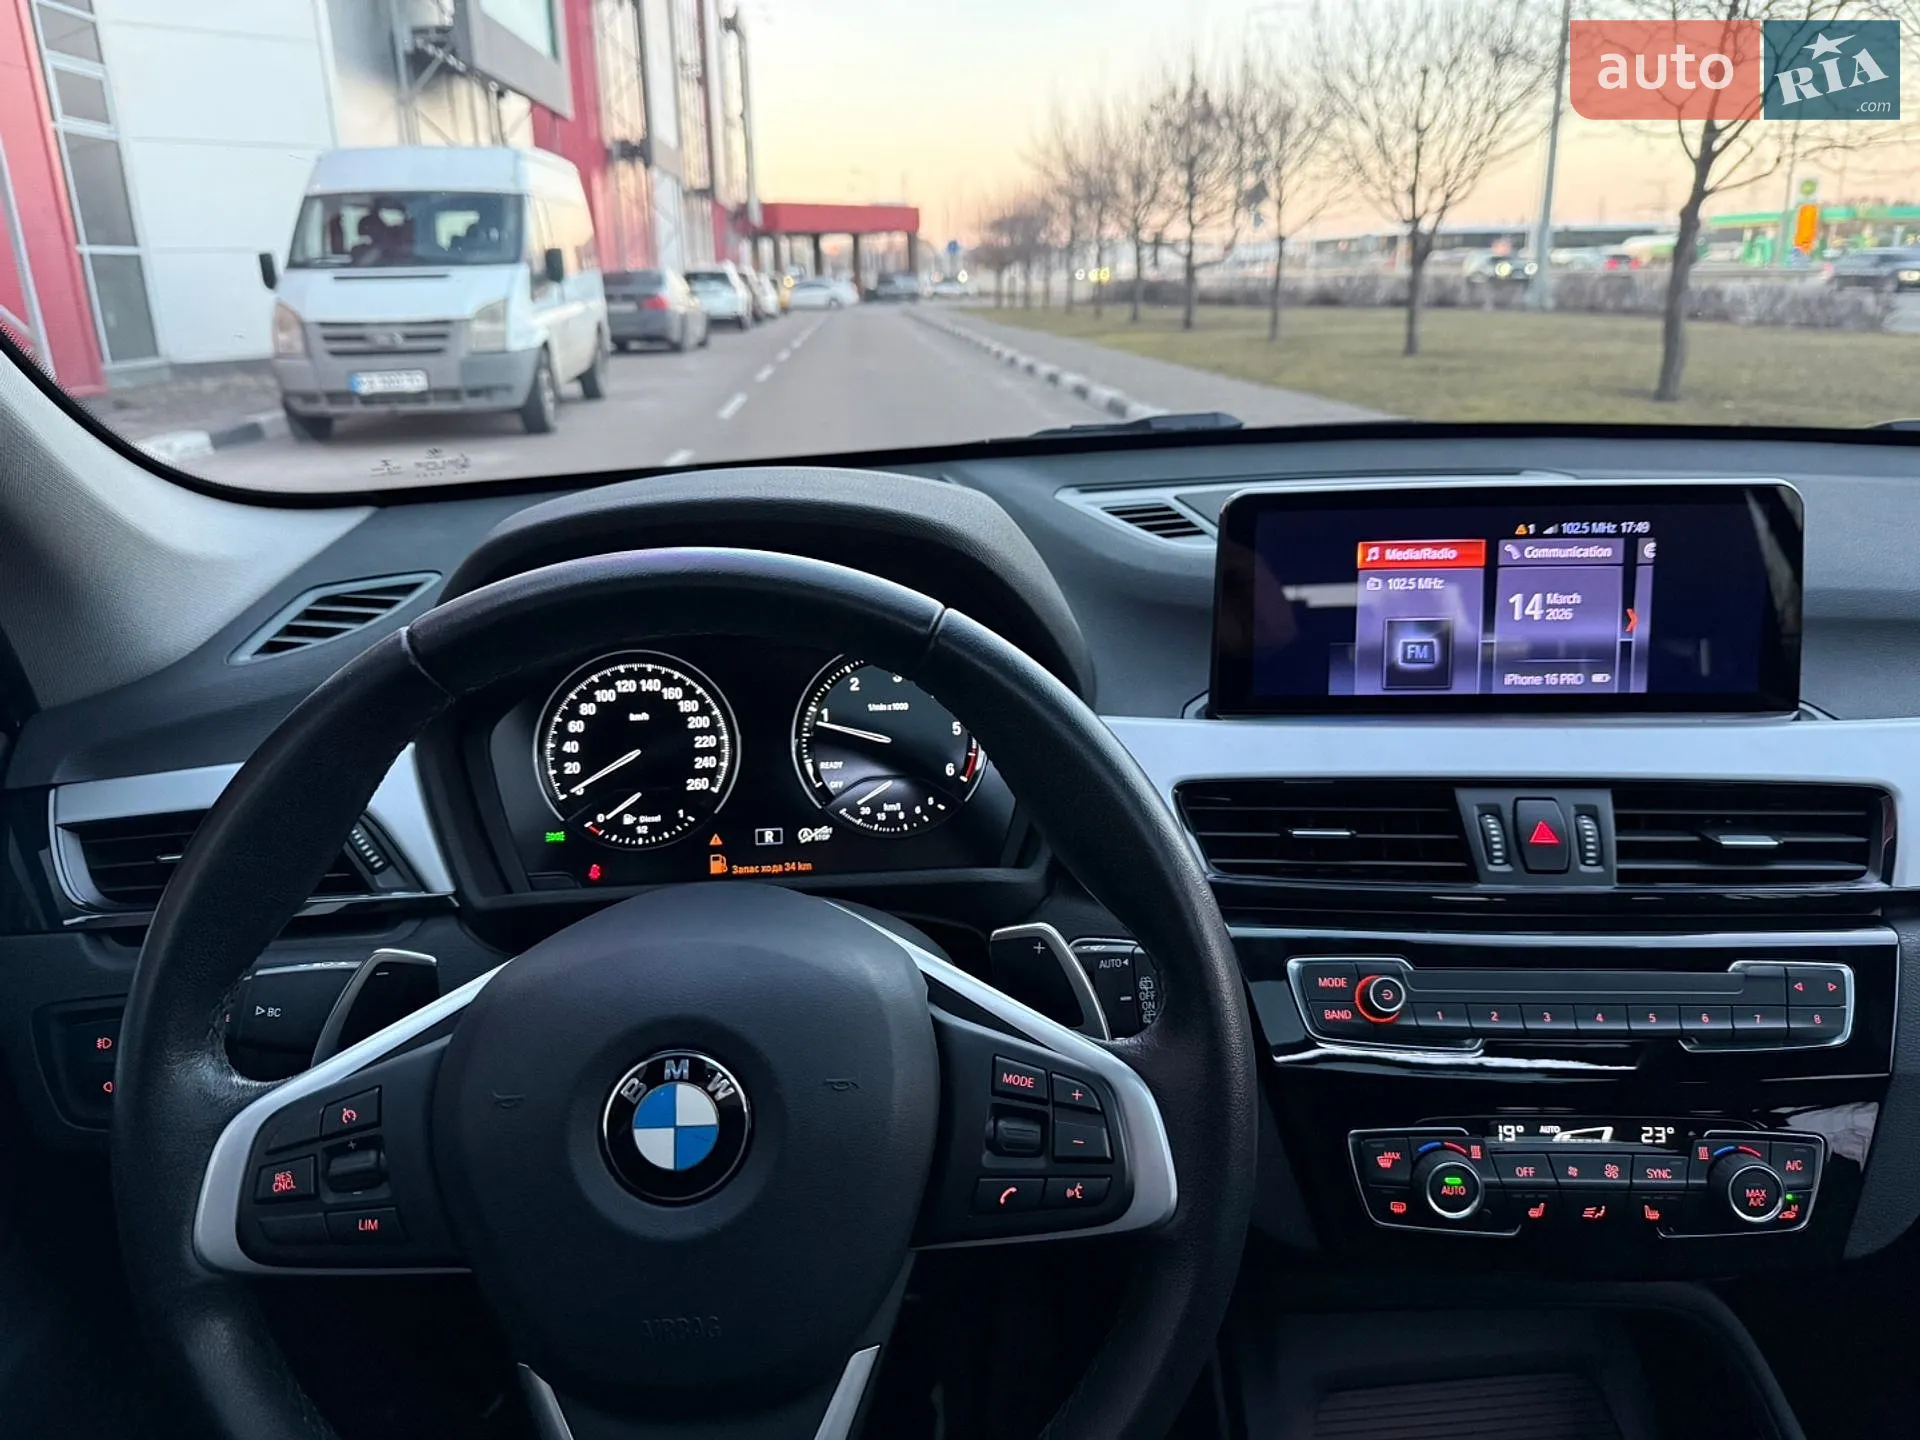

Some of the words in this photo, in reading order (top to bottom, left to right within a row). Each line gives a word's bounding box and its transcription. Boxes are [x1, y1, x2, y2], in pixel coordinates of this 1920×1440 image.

[1528, 524, 1535, 535] 1
[1590, 521, 1617, 535] MHz
[1621, 520, 1649, 535] 17:49
[1384, 546, 1458, 562] Media/Radio
[1523, 545, 1613, 562] Communication
[1387, 577, 1415, 591] 102.5
[1417, 577, 1445, 590] MHz
[1545, 592, 1582, 606] March
[1508, 592, 1544, 622] 14
[1545, 608, 1574, 621] 2026
[1407, 643, 1428, 660] FM
[615, 679, 637, 693] 120
[639, 678, 661, 692] 140
[849, 677, 860, 692] 2
[1504, 673, 1544, 687] iPhone
[1545, 673, 1560, 687] 16
[1561, 673, 1585, 687] PRO
[594, 688, 617, 702] 100
[661, 687, 683, 700] 160
[579, 702, 596, 716] 80
[678, 700, 699, 713] 180
[820, 708, 829, 722] 1
[568, 720, 585, 733] 60
[688, 716, 710, 730] 200
[951, 721, 962, 735] 5
[562, 741, 579, 754] 40
[694, 735, 717, 748] 220
[564, 762, 581, 775] 20
[694, 756, 717, 769] 240
[819, 761, 844, 770] READY
[945, 762, 956, 777] 6
[686, 778, 709, 791] 260
[829, 781, 845, 789] OFF
[596, 812, 605, 823] 0
[859, 806, 871, 816] 30
[876, 812, 886, 821] 15
[638, 814, 662, 824] Diesel
[763, 830, 773, 842] R
[731, 864, 760, 874] Запас
[761, 863, 783, 874] хода
[784, 861, 797, 872] 34
[797, 861, 813, 871] km
[1099, 959, 1122, 971] AUTO
[1318, 977, 1348, 991] MODE
[268, 1008, 282, 1018] BC
[1324, 1010, 1353, 1023] BAND
[1436, 1011, 1443, 1021] 1
[1490, 1011, 1499, 1022] 2
[1543, 1012, 1552, 1023] 3
[1595, 1012, 1604, 1023] 4
[1648, 1013, 1656, 1024] 5
[1701, 1013, 1709, 1024] 6
[1754, 1013, 1762, 1024] 7
[1813, 1013, 1821, 1025] 8
[620, 1059, 736, 1104] BMW
[1002, 1072, 1035, 1089] MODE
[1539, 1124, 1561, 1134] AUTO
[1641, 1126, 1676, 1144] 23°
[1384, 1152, 1401, 1160] MAX
[1515, 1166, 1536, 1177] OFF
[1784, 1159, 1803, 1171] A/C
[275, 1170, 293, 1182] RES
[1646, 1167, 1672, 1180] SYNC
[273, 1179, 297, 1192] CNCL
[1441, 1186, 1466, 1197] AUTO
[1745, 1188, 1767, 1198] MAX
[1748, 1197, 1765, 1208] A/C
[358, 1219, 379, 1231] LIM
[640, 1314, 721, 1343] AIRBAG
